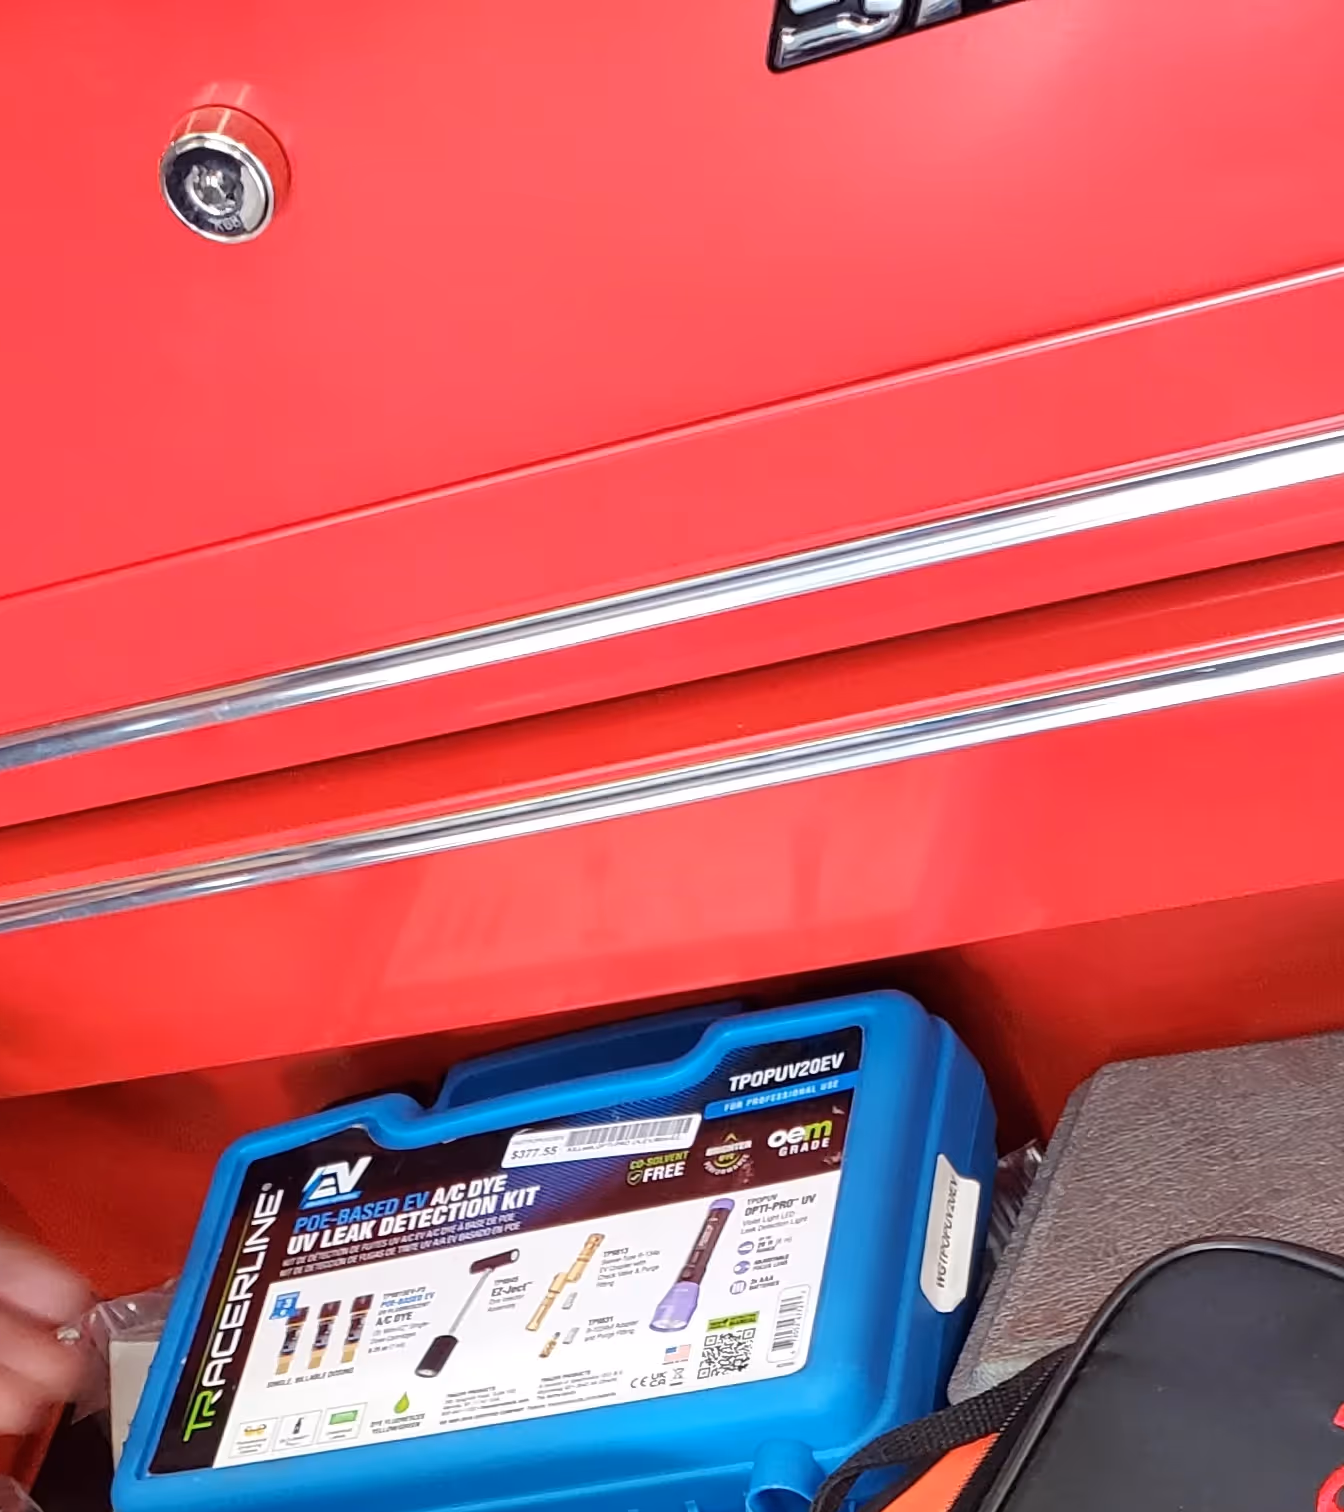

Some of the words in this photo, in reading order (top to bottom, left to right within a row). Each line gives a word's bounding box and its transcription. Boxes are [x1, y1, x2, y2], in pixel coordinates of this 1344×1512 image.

[728, 1051, 846, 1093] TPOPUV20EV
[744, 1083, 818, 1108] PROFESSIONAL
[767, 1119, 834, 1149] oem
[778, 1138, 832, 1157] GRADE
[510, 1146, 559, 1160] $377.55
[301, 1155, 374, 1202] EV
[641, 1160, 686, 1183] FREE
[292, 1196, 401, 1235] POE-BASED
[403, 1190, 431, 1212] EV
[429, 1180, 467, 1208] A/C
[466, 1173, 509, 1195] DYE
[799, 1192, 817, 1206] UV
[286, 1232, 320, 1256] UV
[319, 1219, 381, 1250] LEAK
[377, 1195, 504, 1237] DETECTION
[500, 1185, 541, 1211] KIT
